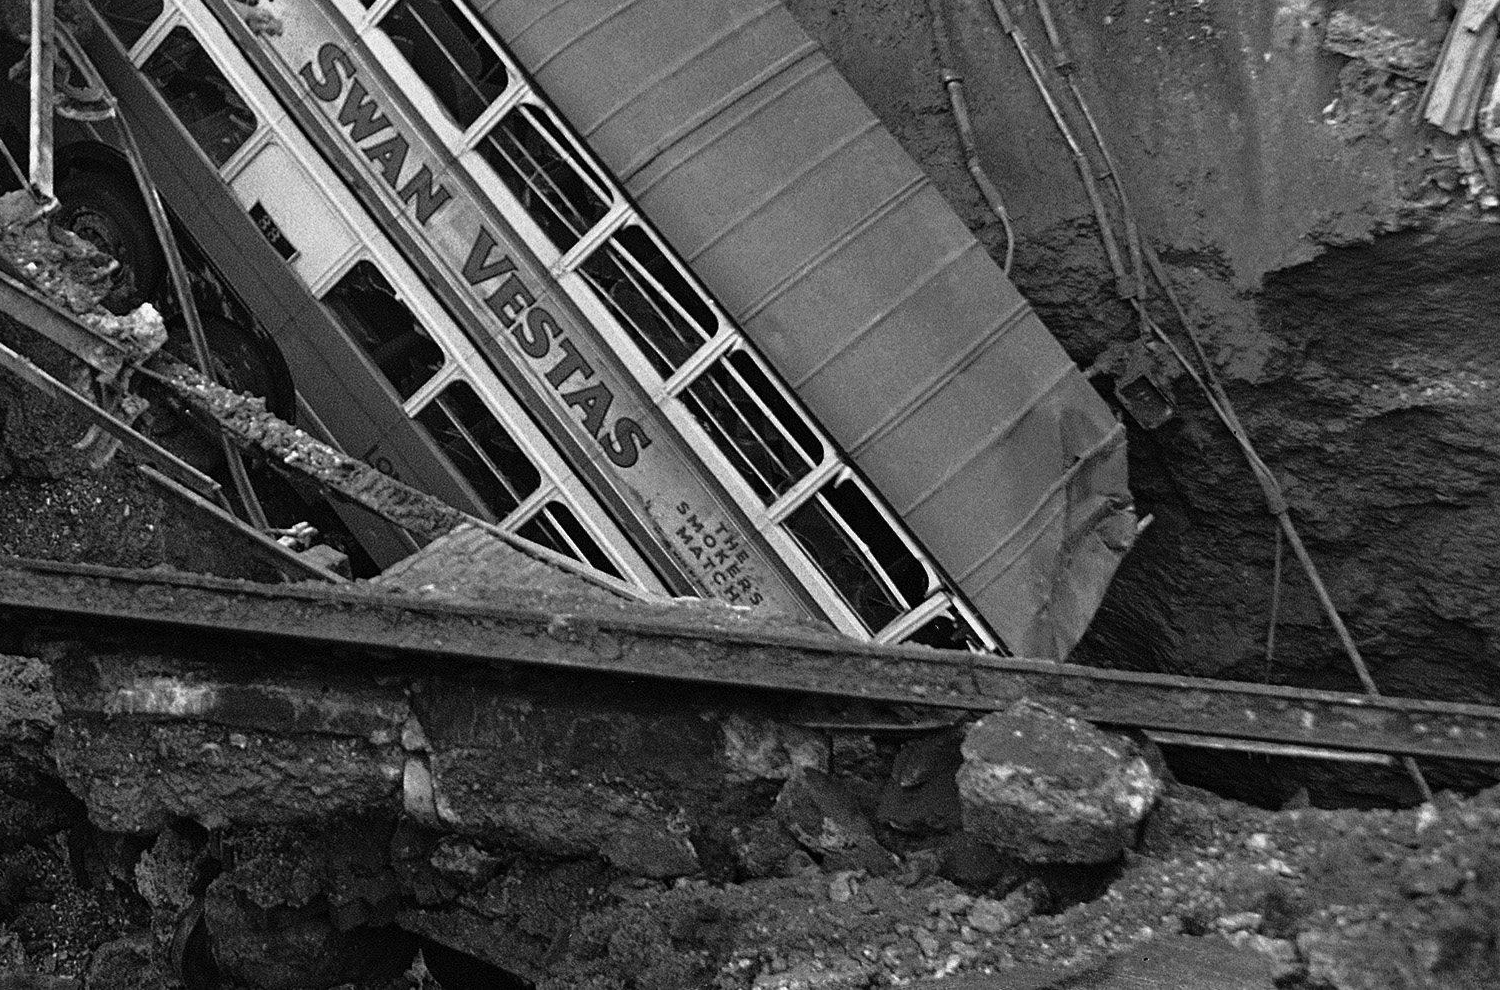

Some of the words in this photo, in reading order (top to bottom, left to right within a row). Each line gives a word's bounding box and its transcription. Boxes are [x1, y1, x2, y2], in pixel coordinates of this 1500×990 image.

[300, 41, 452, 226] SWAN
[460, 227, 653, 469] VESTAS
[676, 501, 764, 606] SMOKERS
[676, 526, 741, 603] MATCH
[715, 522, 750, 564] THE
